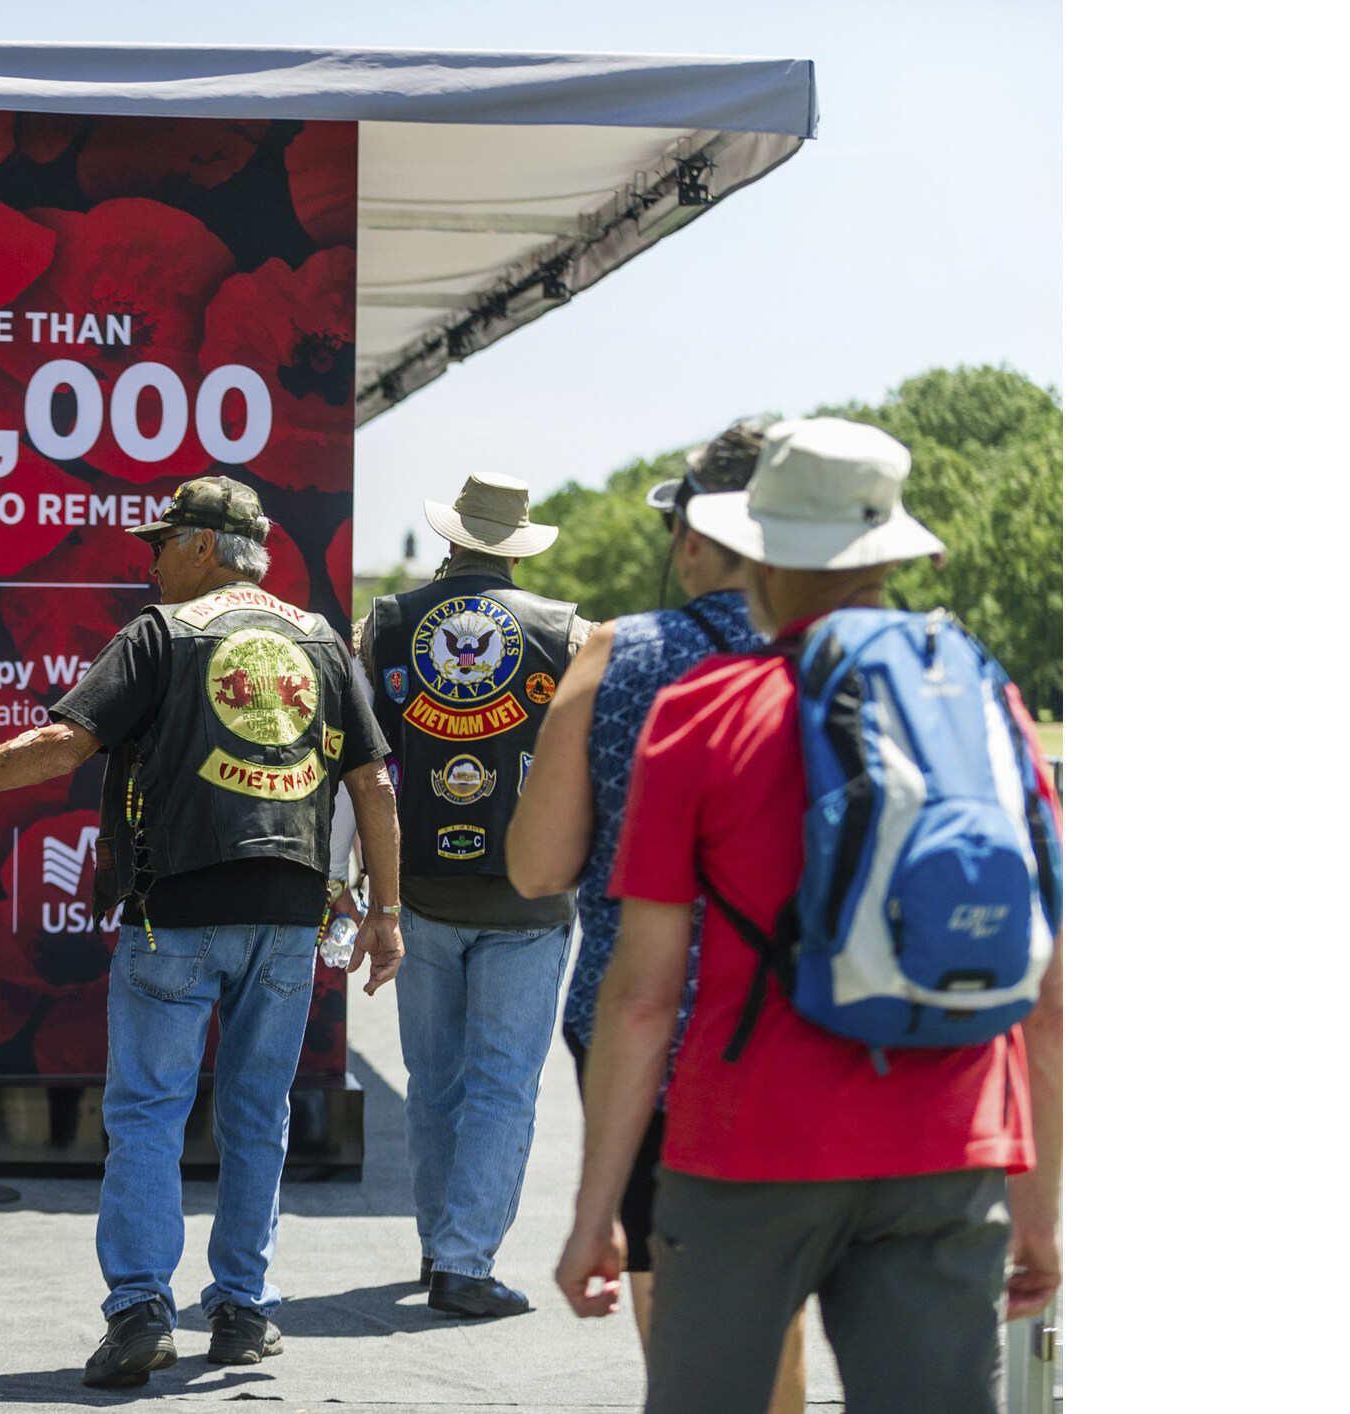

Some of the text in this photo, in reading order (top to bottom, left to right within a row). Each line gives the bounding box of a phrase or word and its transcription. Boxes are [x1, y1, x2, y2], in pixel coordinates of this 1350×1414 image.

[26, 312, 131, 346] THAN
[416, 600, 519, 656] UNITED STATES
[431, 674, 499, 699] NAVY
[412, 699, 519, 736] VIETNAM VET
[219, 763, 316, 792] VIETNAM
[442, 835, 481, 848] A C
